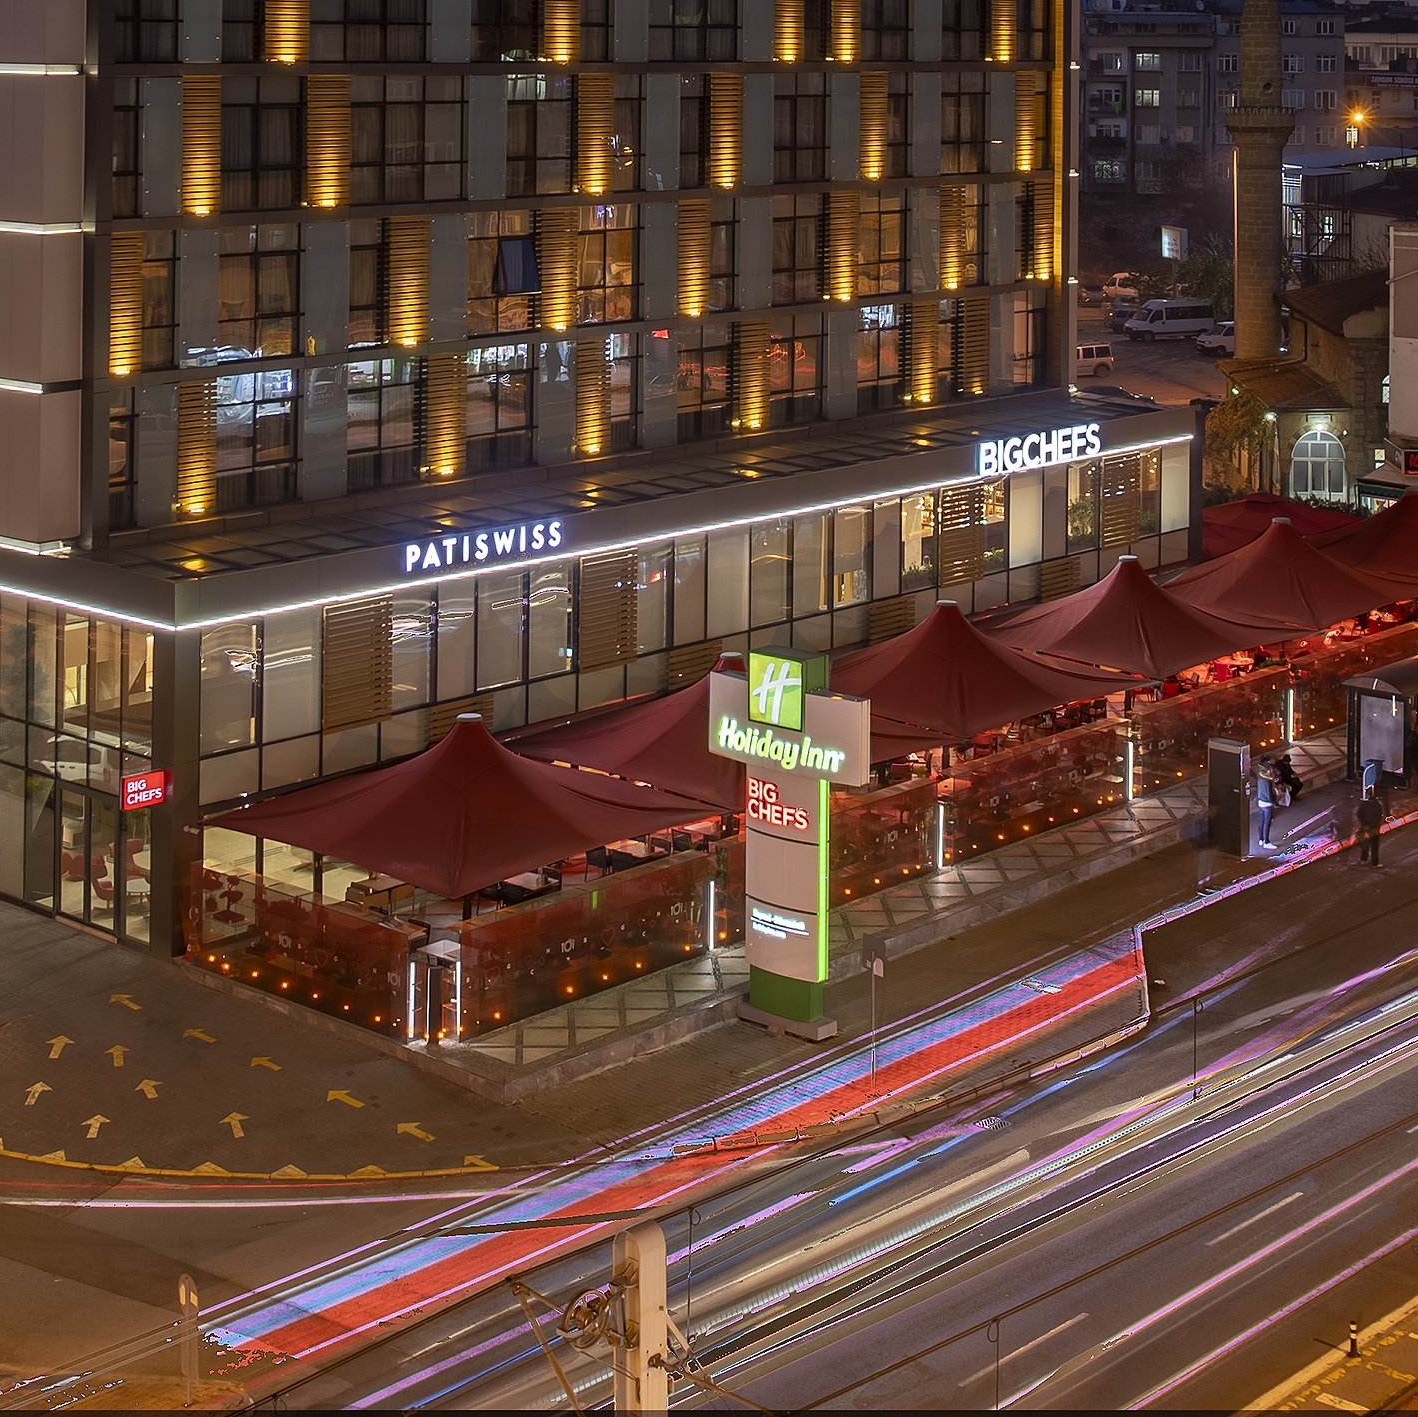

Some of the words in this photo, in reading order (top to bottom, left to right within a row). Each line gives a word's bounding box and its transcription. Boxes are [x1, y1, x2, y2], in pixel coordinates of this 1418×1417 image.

[979, 423, 1102, 477] BIGCHEFS
[405, 521, 562, 572] PATISWISS
[717, 715, 800, 771] Holiday
[800, 736, 841, 773] Inn
[126, 779, 147, 793] BIG
[126, 787, 162, 805] CHEFS
[748, 777, 778, 803] BIG
